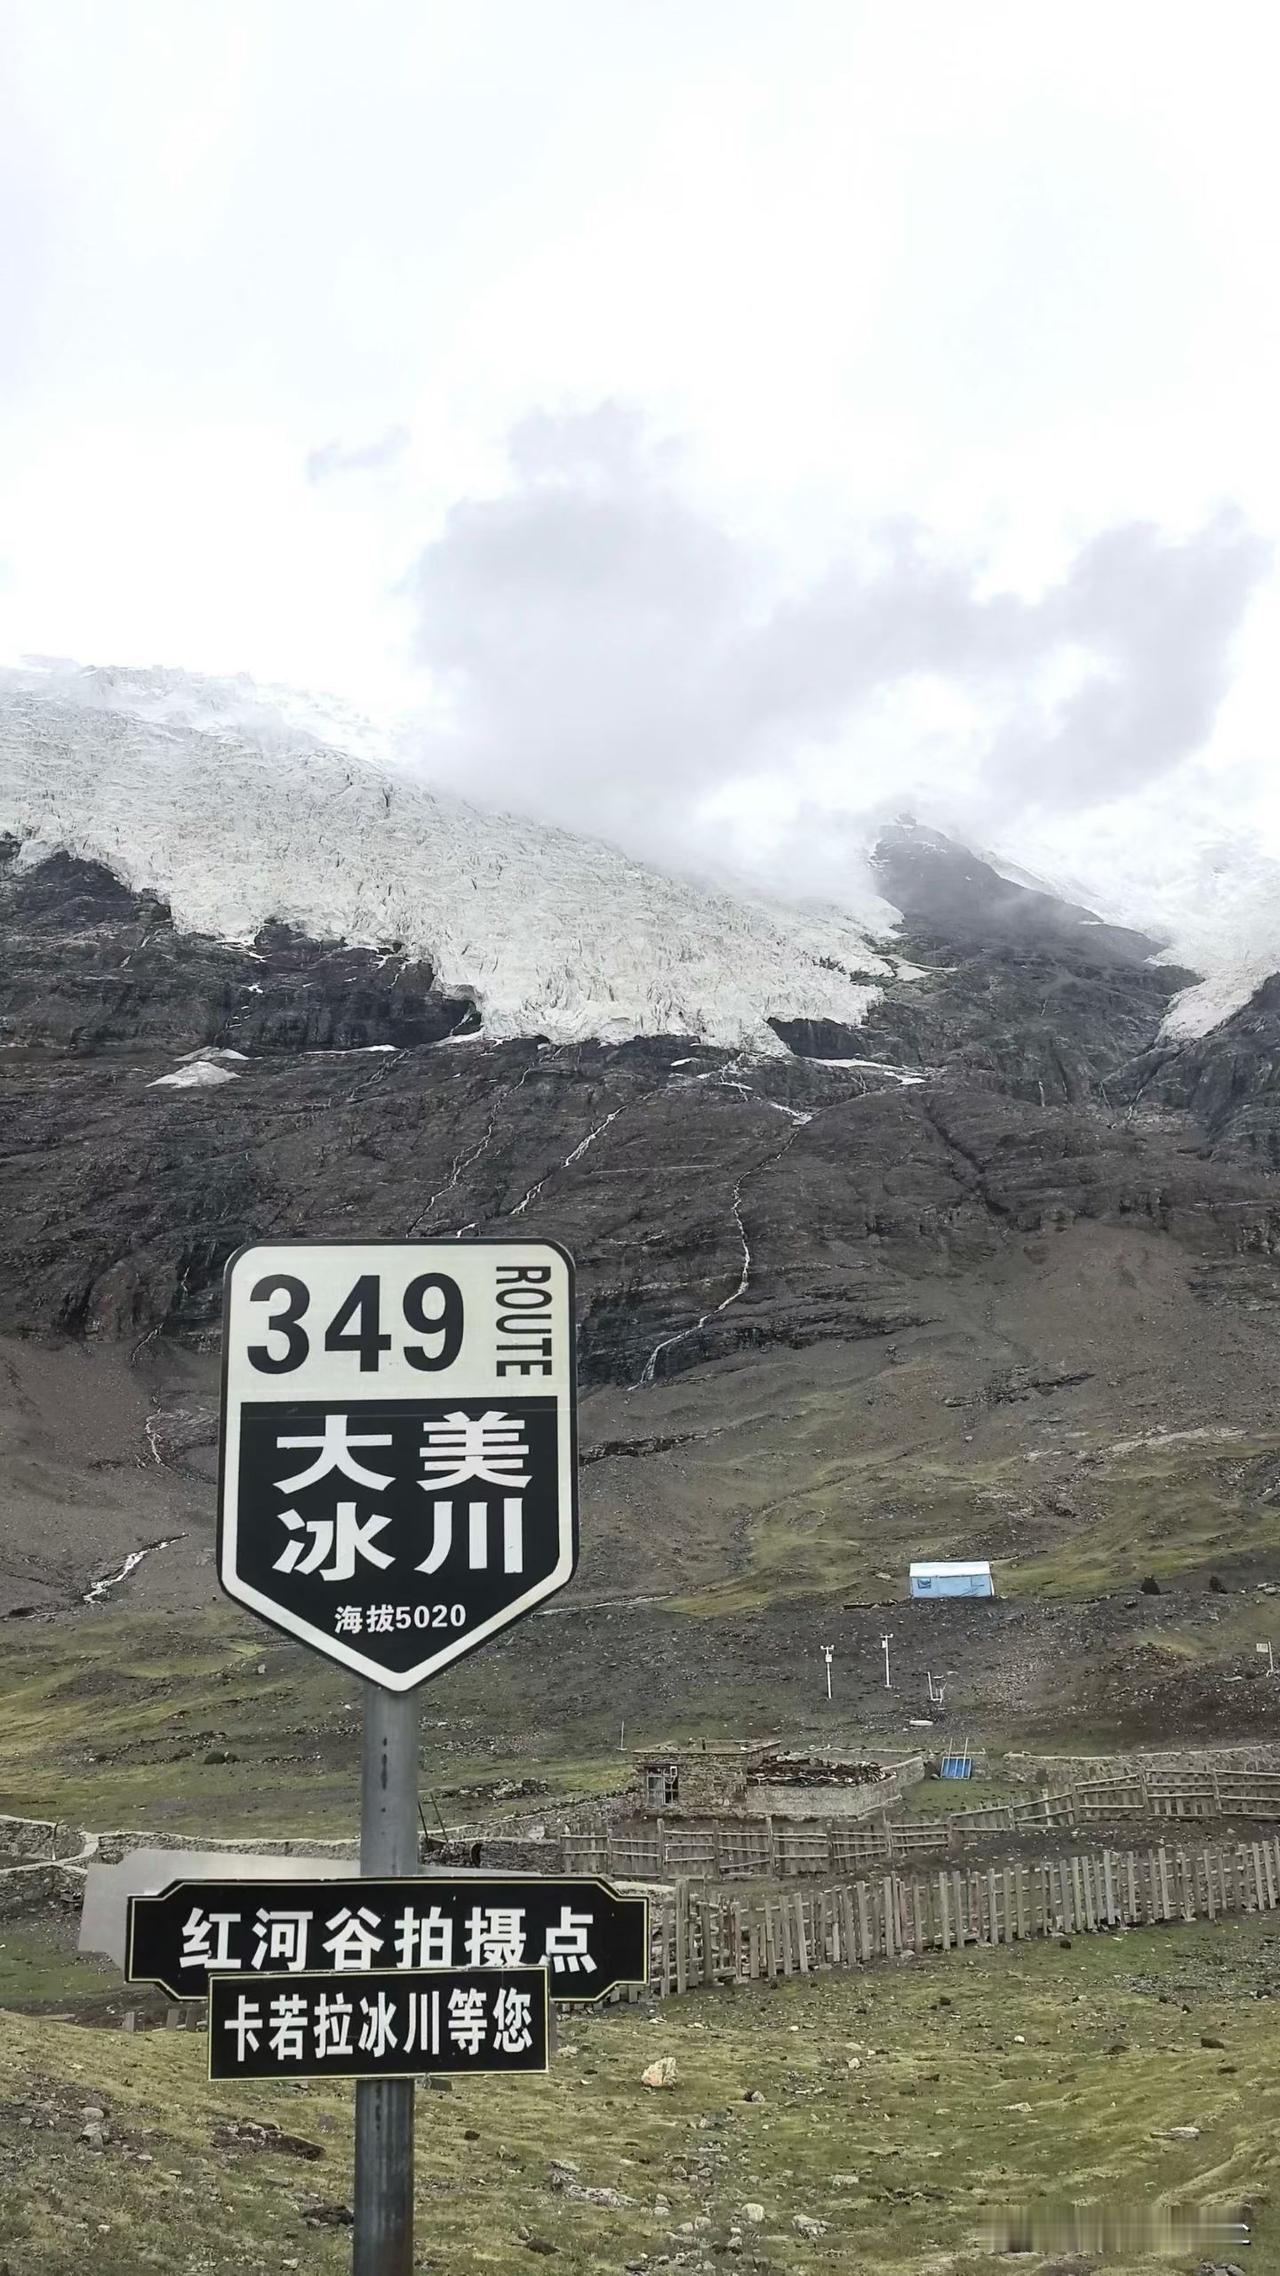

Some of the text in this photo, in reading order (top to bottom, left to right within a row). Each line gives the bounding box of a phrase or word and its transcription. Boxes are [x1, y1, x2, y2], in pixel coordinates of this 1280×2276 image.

[247, 1272, 465, 1375] 349
[495, 1265, 553, 1378] ROUTE
[272, 1410, 533, 1494] 大美
[271, 1497, 524, 1582] 冰川
[334, 1603, 467, 1634] 海拔5020
[179, 1906, 598, 1974] 红河谷拍摄点
[223, 1987, 533, 2063] 卡若拉冰川等您
